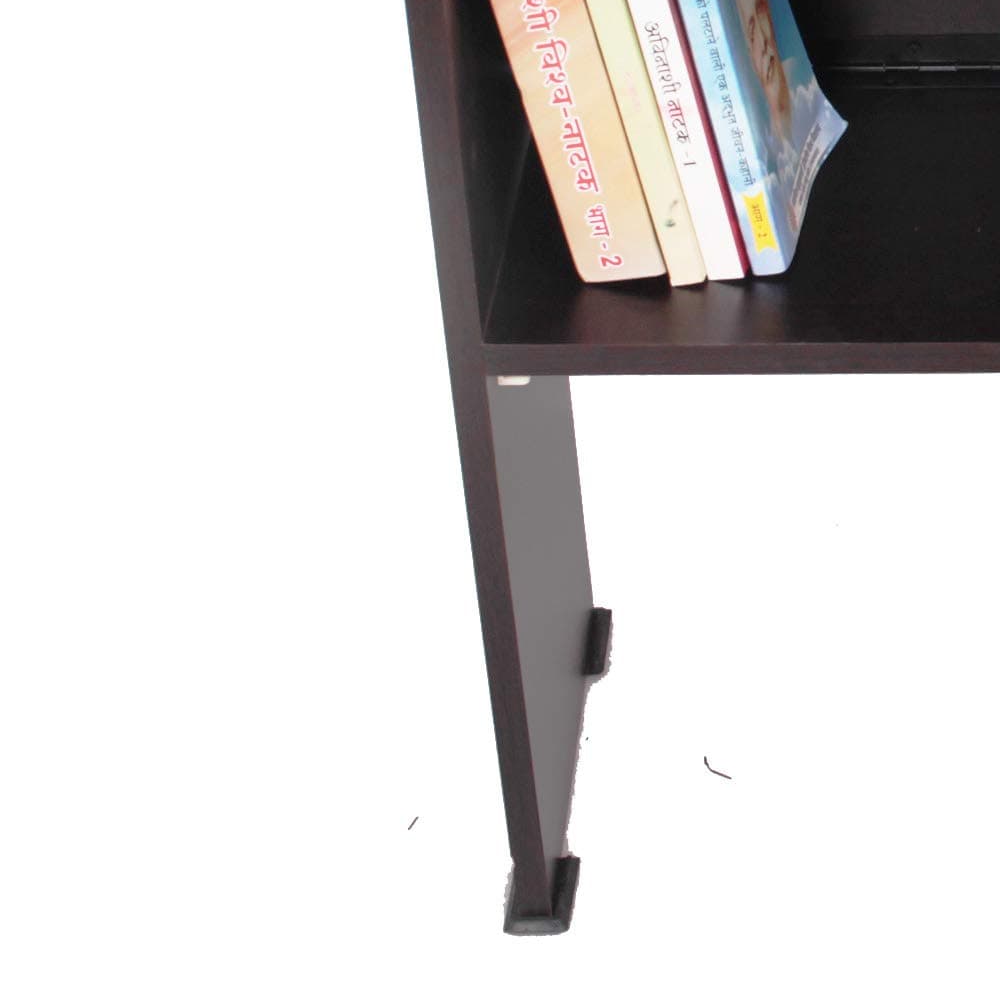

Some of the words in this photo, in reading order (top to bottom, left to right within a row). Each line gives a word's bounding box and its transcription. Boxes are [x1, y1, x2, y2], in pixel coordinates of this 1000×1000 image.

[701, 10, 720, 46] पलटाने
[709, 50, 726, 74] वाली
[644, 20, 682, 95] अविनाशी
[667, 98, 691, 144] नाटक
[717, 73, 729, 91] एक
[586, 204, 610, 238] भाग
[600, 254, 623, 269] 2
